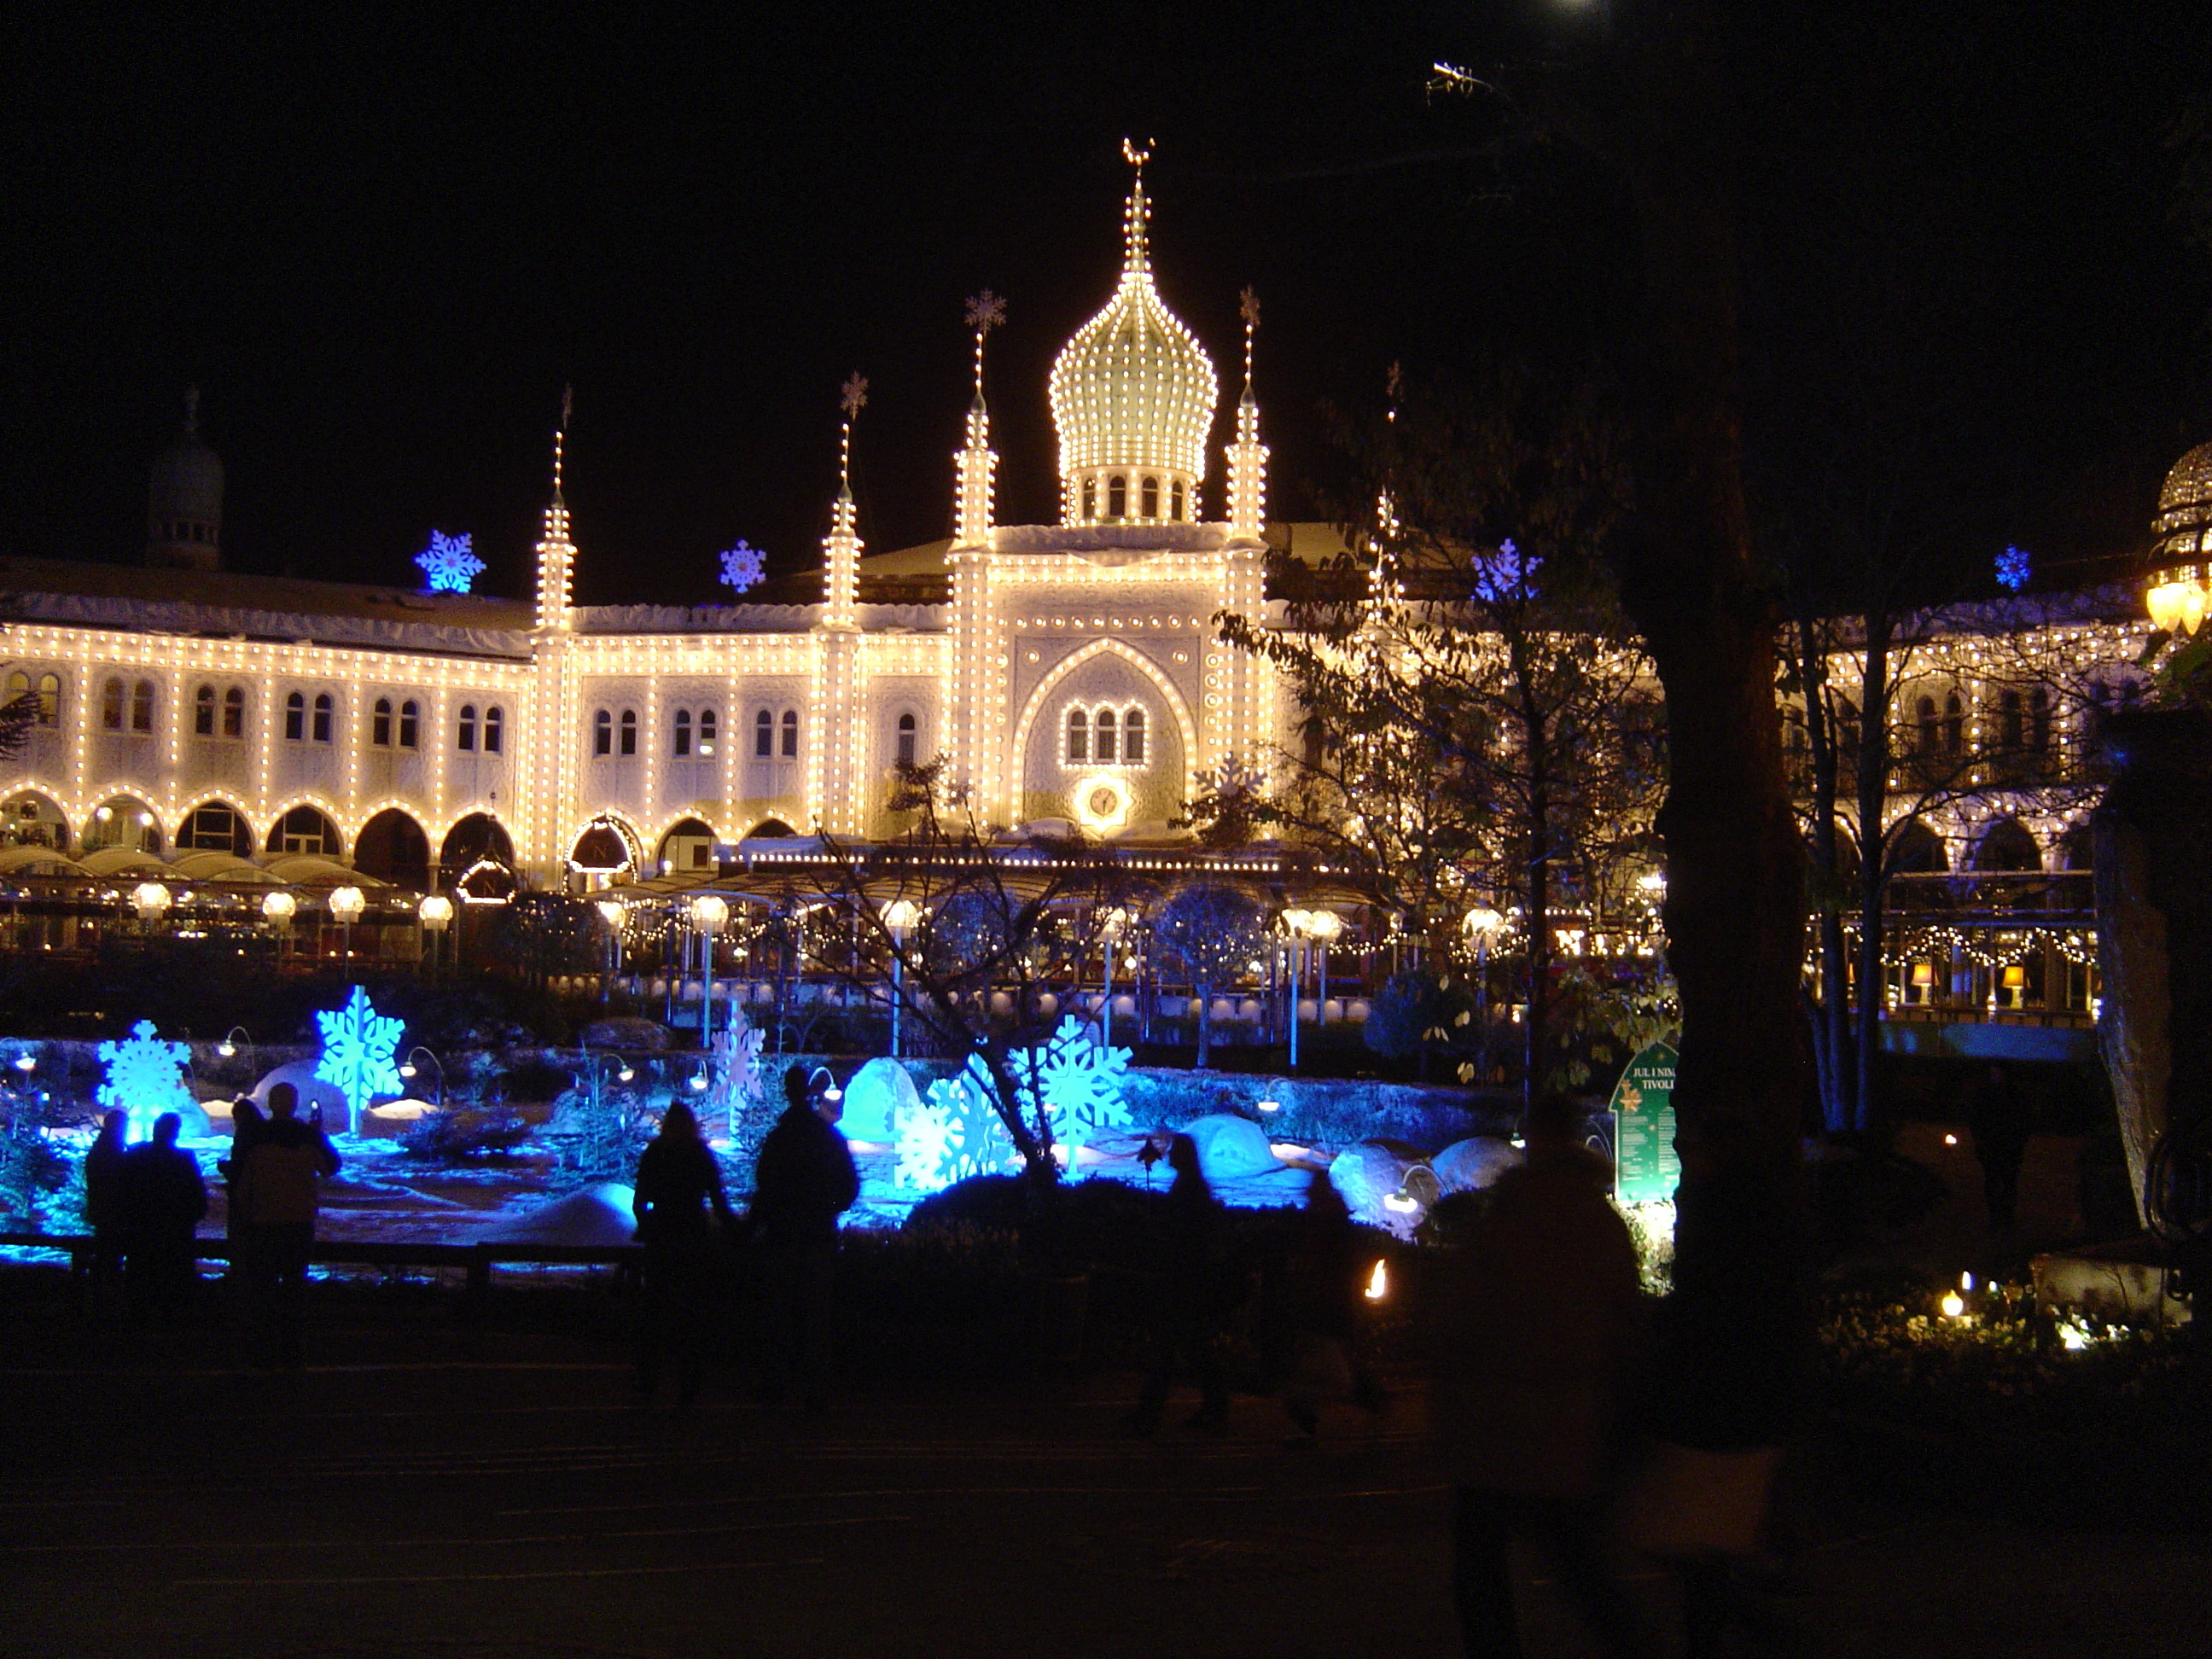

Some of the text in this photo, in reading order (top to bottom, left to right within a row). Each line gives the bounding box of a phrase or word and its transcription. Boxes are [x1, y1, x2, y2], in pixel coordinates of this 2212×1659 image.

[1633, 1067, 1650, 1077] JUL
[1657, 1067, 1676, 1077] NIM
[1642, 1080, 1674, 1090] TIVOLI
